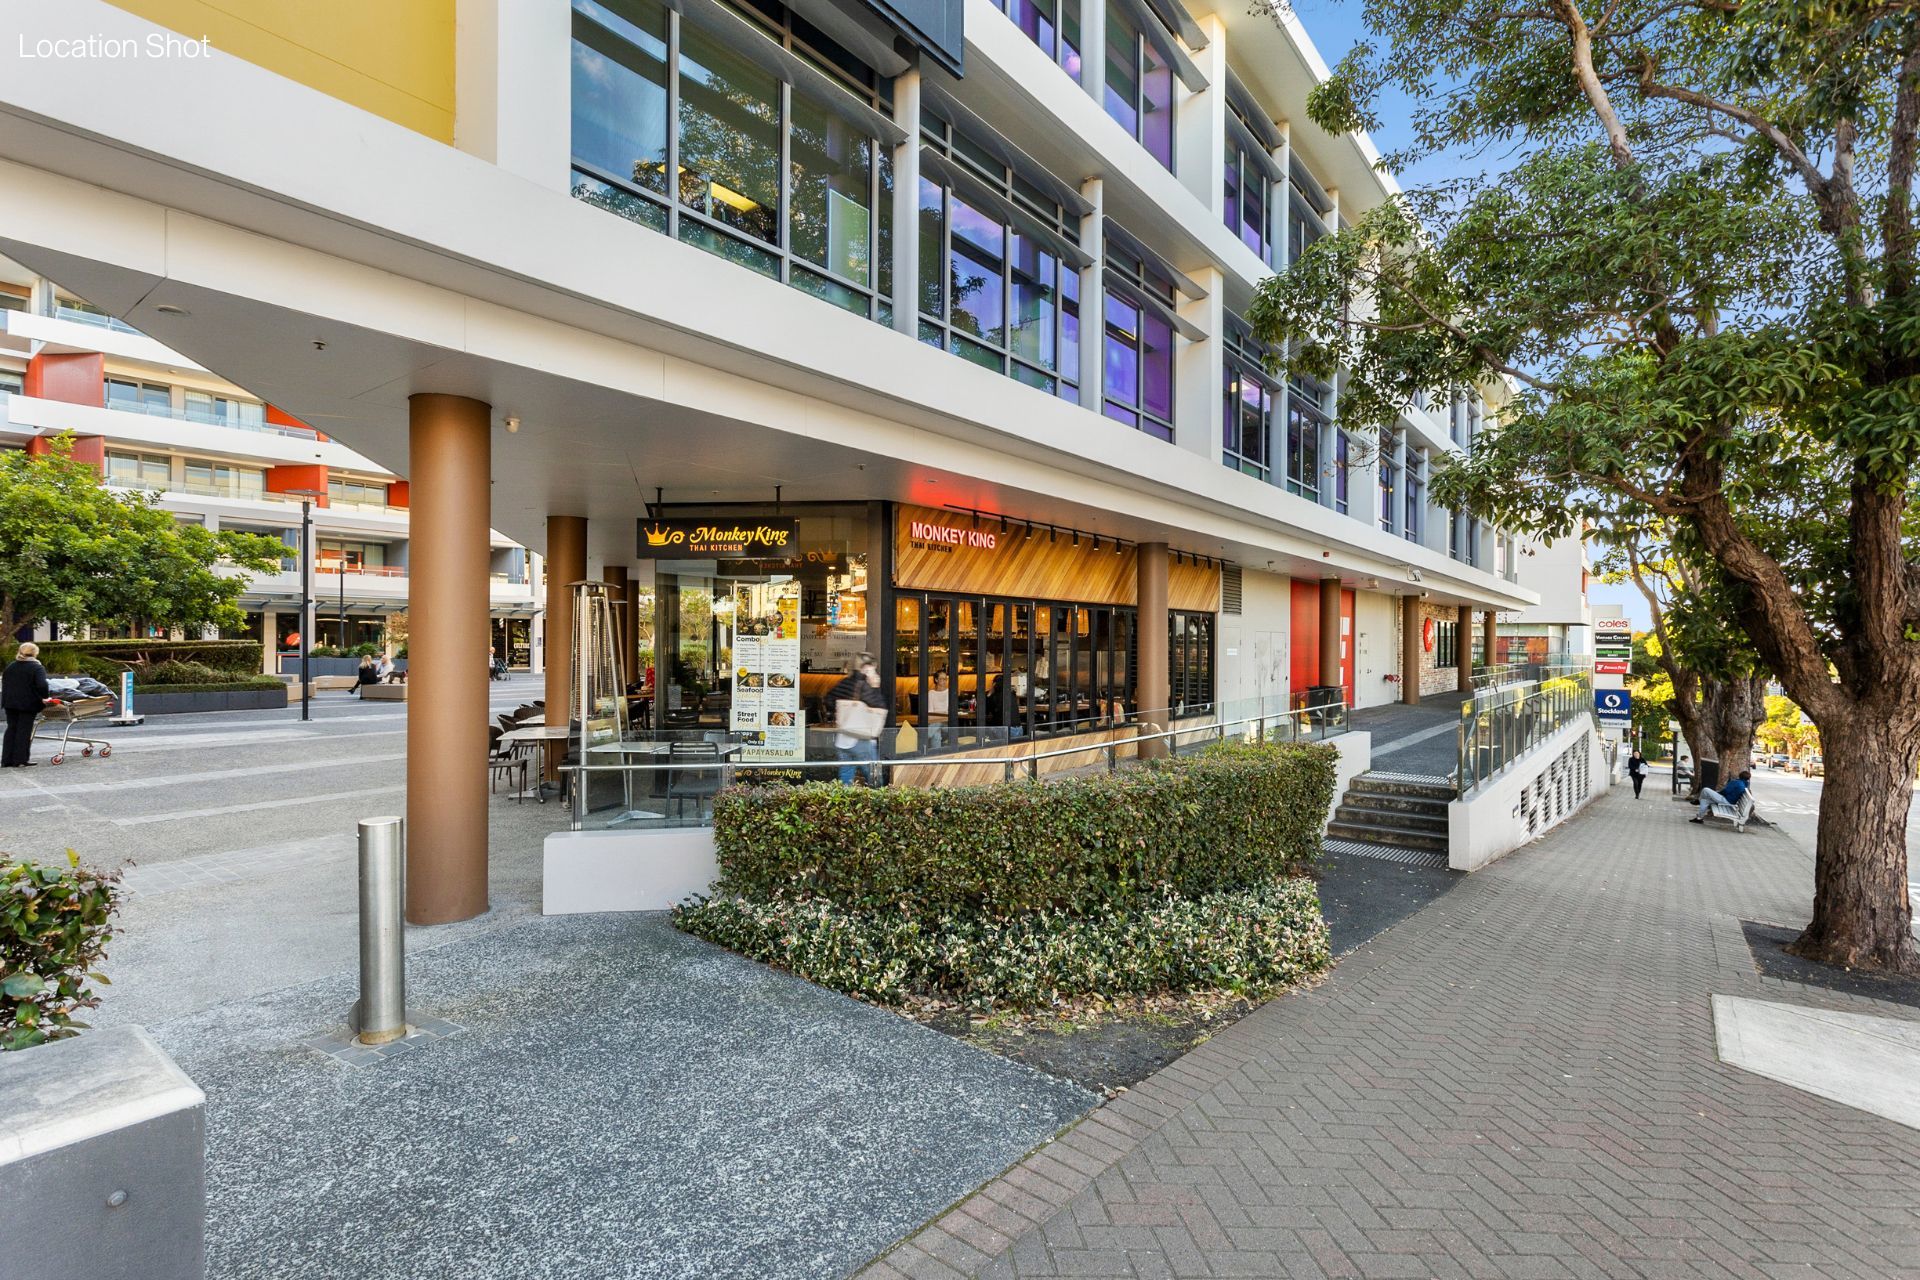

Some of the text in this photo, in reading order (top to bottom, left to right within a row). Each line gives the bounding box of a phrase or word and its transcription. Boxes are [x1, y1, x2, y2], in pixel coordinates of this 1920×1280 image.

[911, 521, 996, 549] MONKEY KING
[911, 541, 952, 553] THAI KITCHEN
